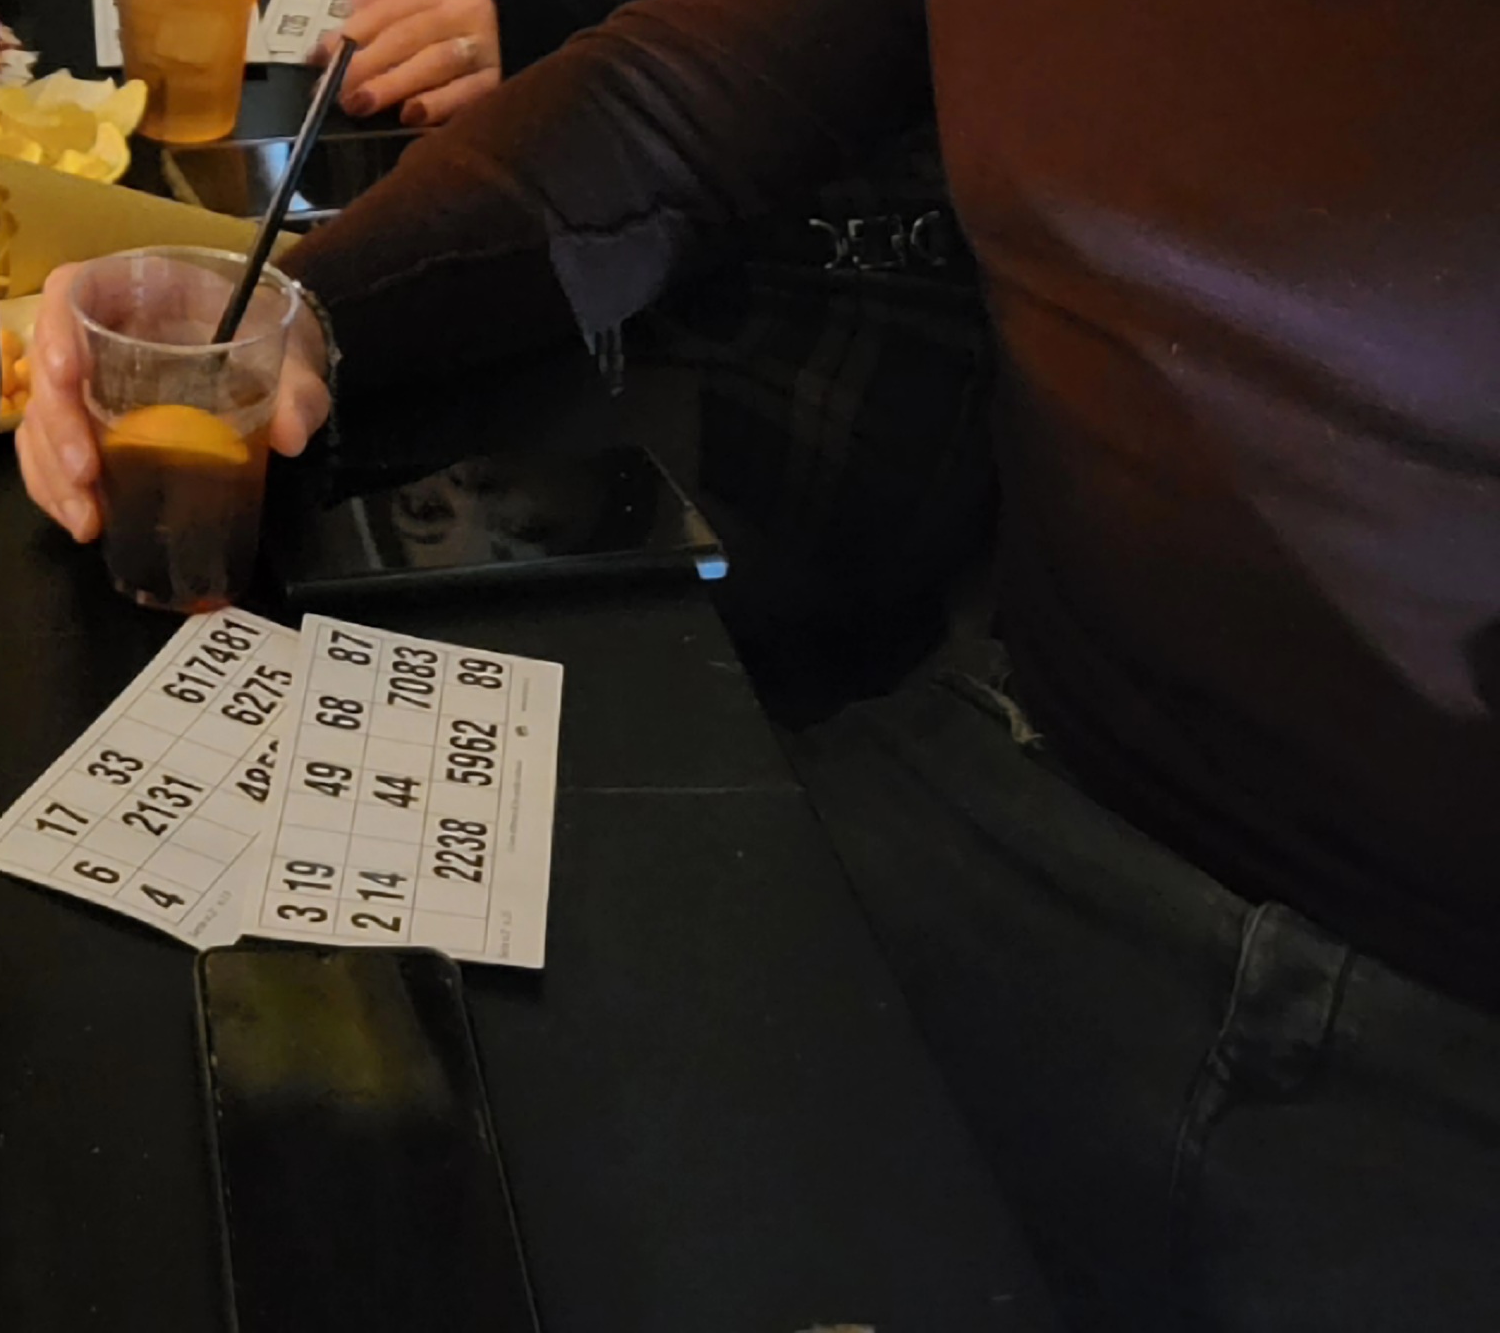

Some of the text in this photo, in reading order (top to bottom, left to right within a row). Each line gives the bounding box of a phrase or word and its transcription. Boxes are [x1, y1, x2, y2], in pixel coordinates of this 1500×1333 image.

[456, 657, 504, 690] 89
[277, 629, 374, 923] 3 19 49 68 87
[372, 774, 422, 809] 44
[35, 801, 90, 837] 17
[86, 749, 144, 786] 33
[72, 860, 121, 885] 6
[356, 871, 408, 902] 14
[139, 883, 185, 910] 4
[350, 912, 402, 933] 2
